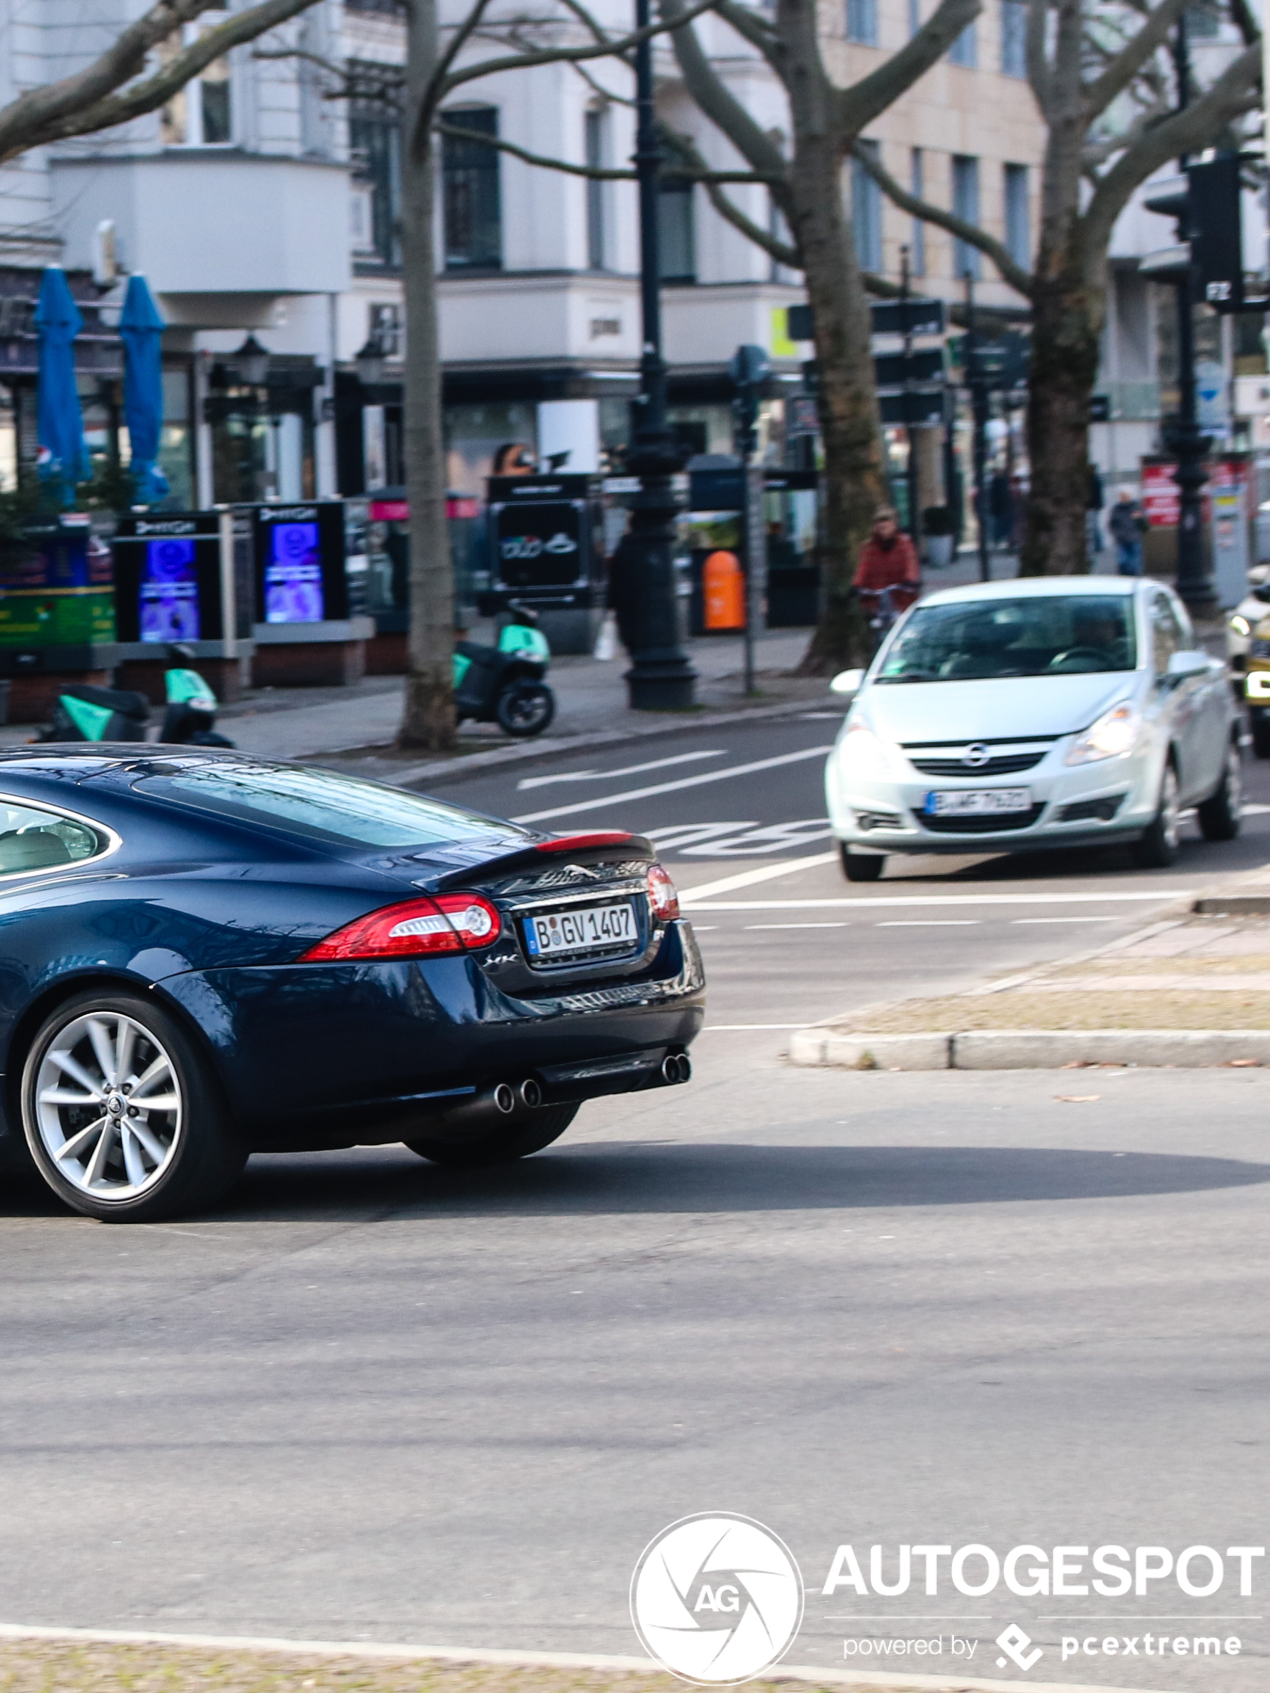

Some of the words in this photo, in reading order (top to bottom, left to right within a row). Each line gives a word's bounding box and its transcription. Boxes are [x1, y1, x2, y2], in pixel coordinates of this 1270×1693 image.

[536, 920, 550, 948] B
[562, 916, 585, 944] GV
[588, 908, 630, 941] 1407
